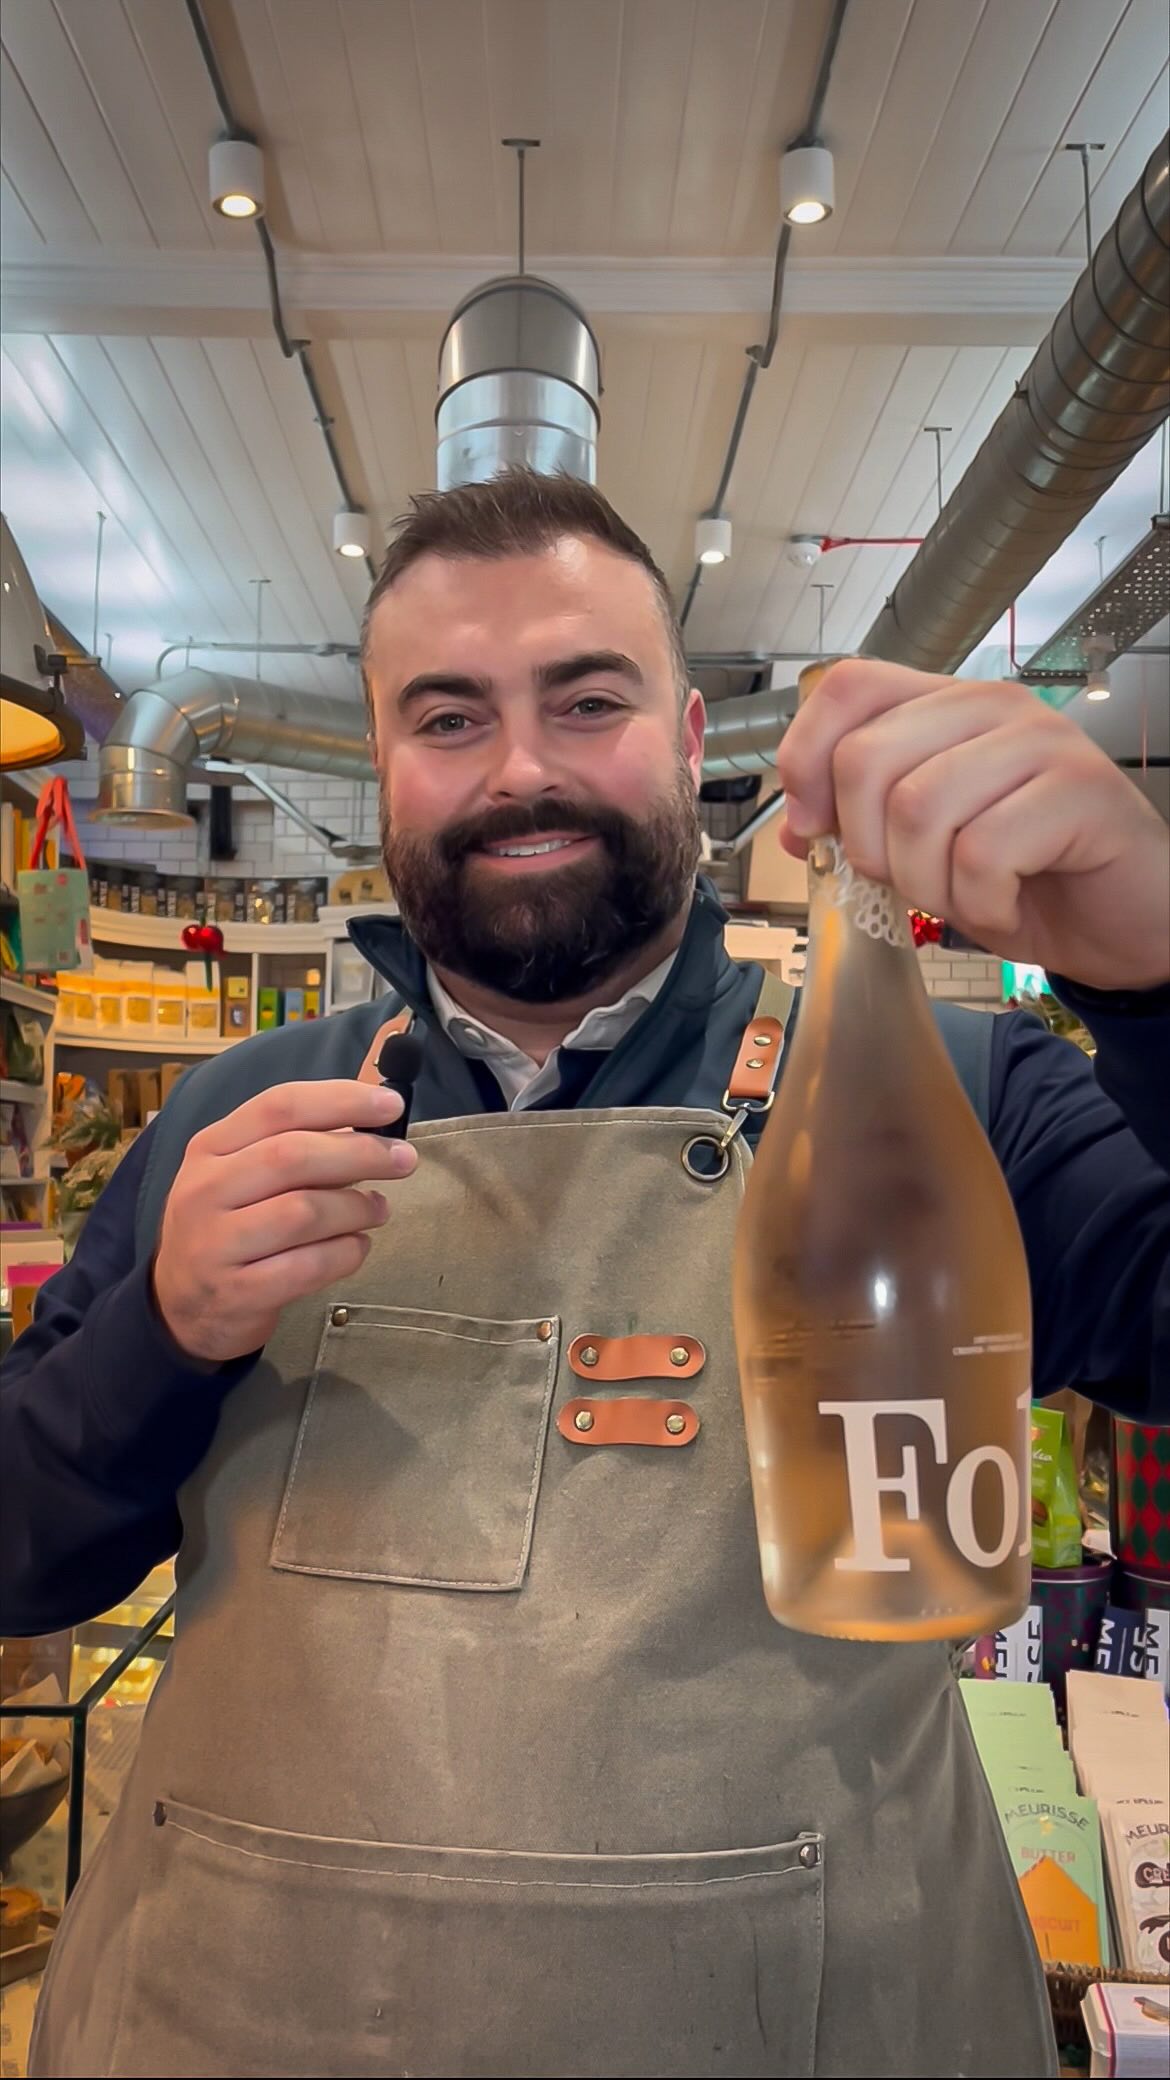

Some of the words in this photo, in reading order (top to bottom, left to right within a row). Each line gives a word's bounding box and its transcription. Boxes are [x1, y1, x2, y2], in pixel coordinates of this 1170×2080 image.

[1004, 1803, 1091, 1831] MEURISSE
[1020, 1846, 1076, 1864] BUTTER
[1033, 1915, 1081, 1933] ISCUIT
